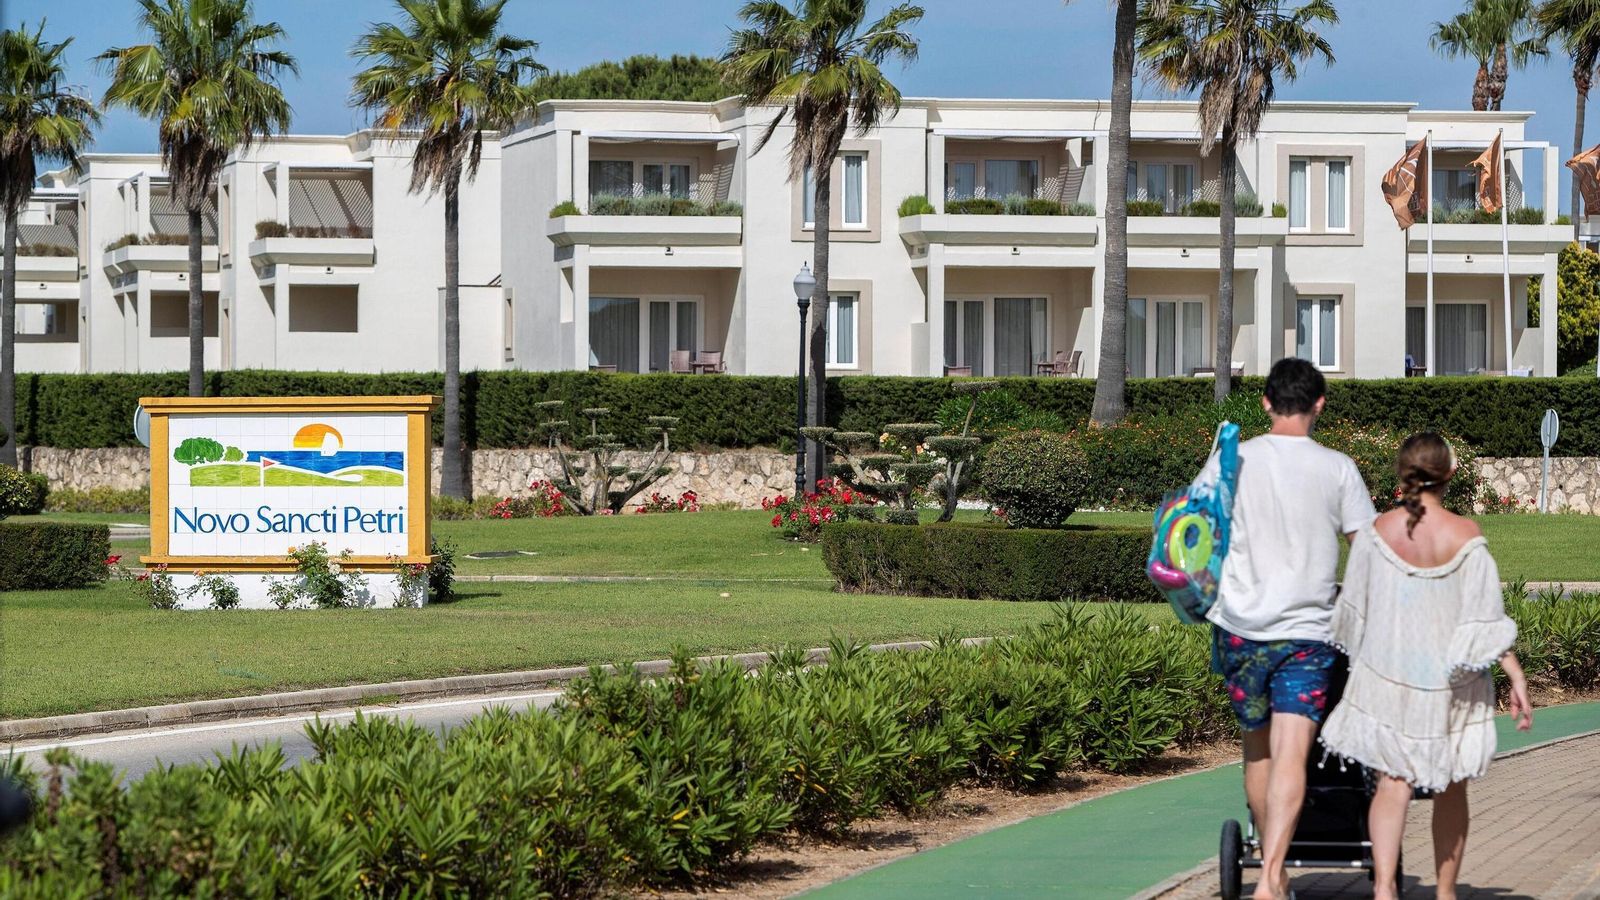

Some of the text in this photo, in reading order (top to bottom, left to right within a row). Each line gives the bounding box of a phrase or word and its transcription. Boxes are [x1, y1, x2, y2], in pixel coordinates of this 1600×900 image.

[174, 505, 404, 534] Novo Sancti Petri
